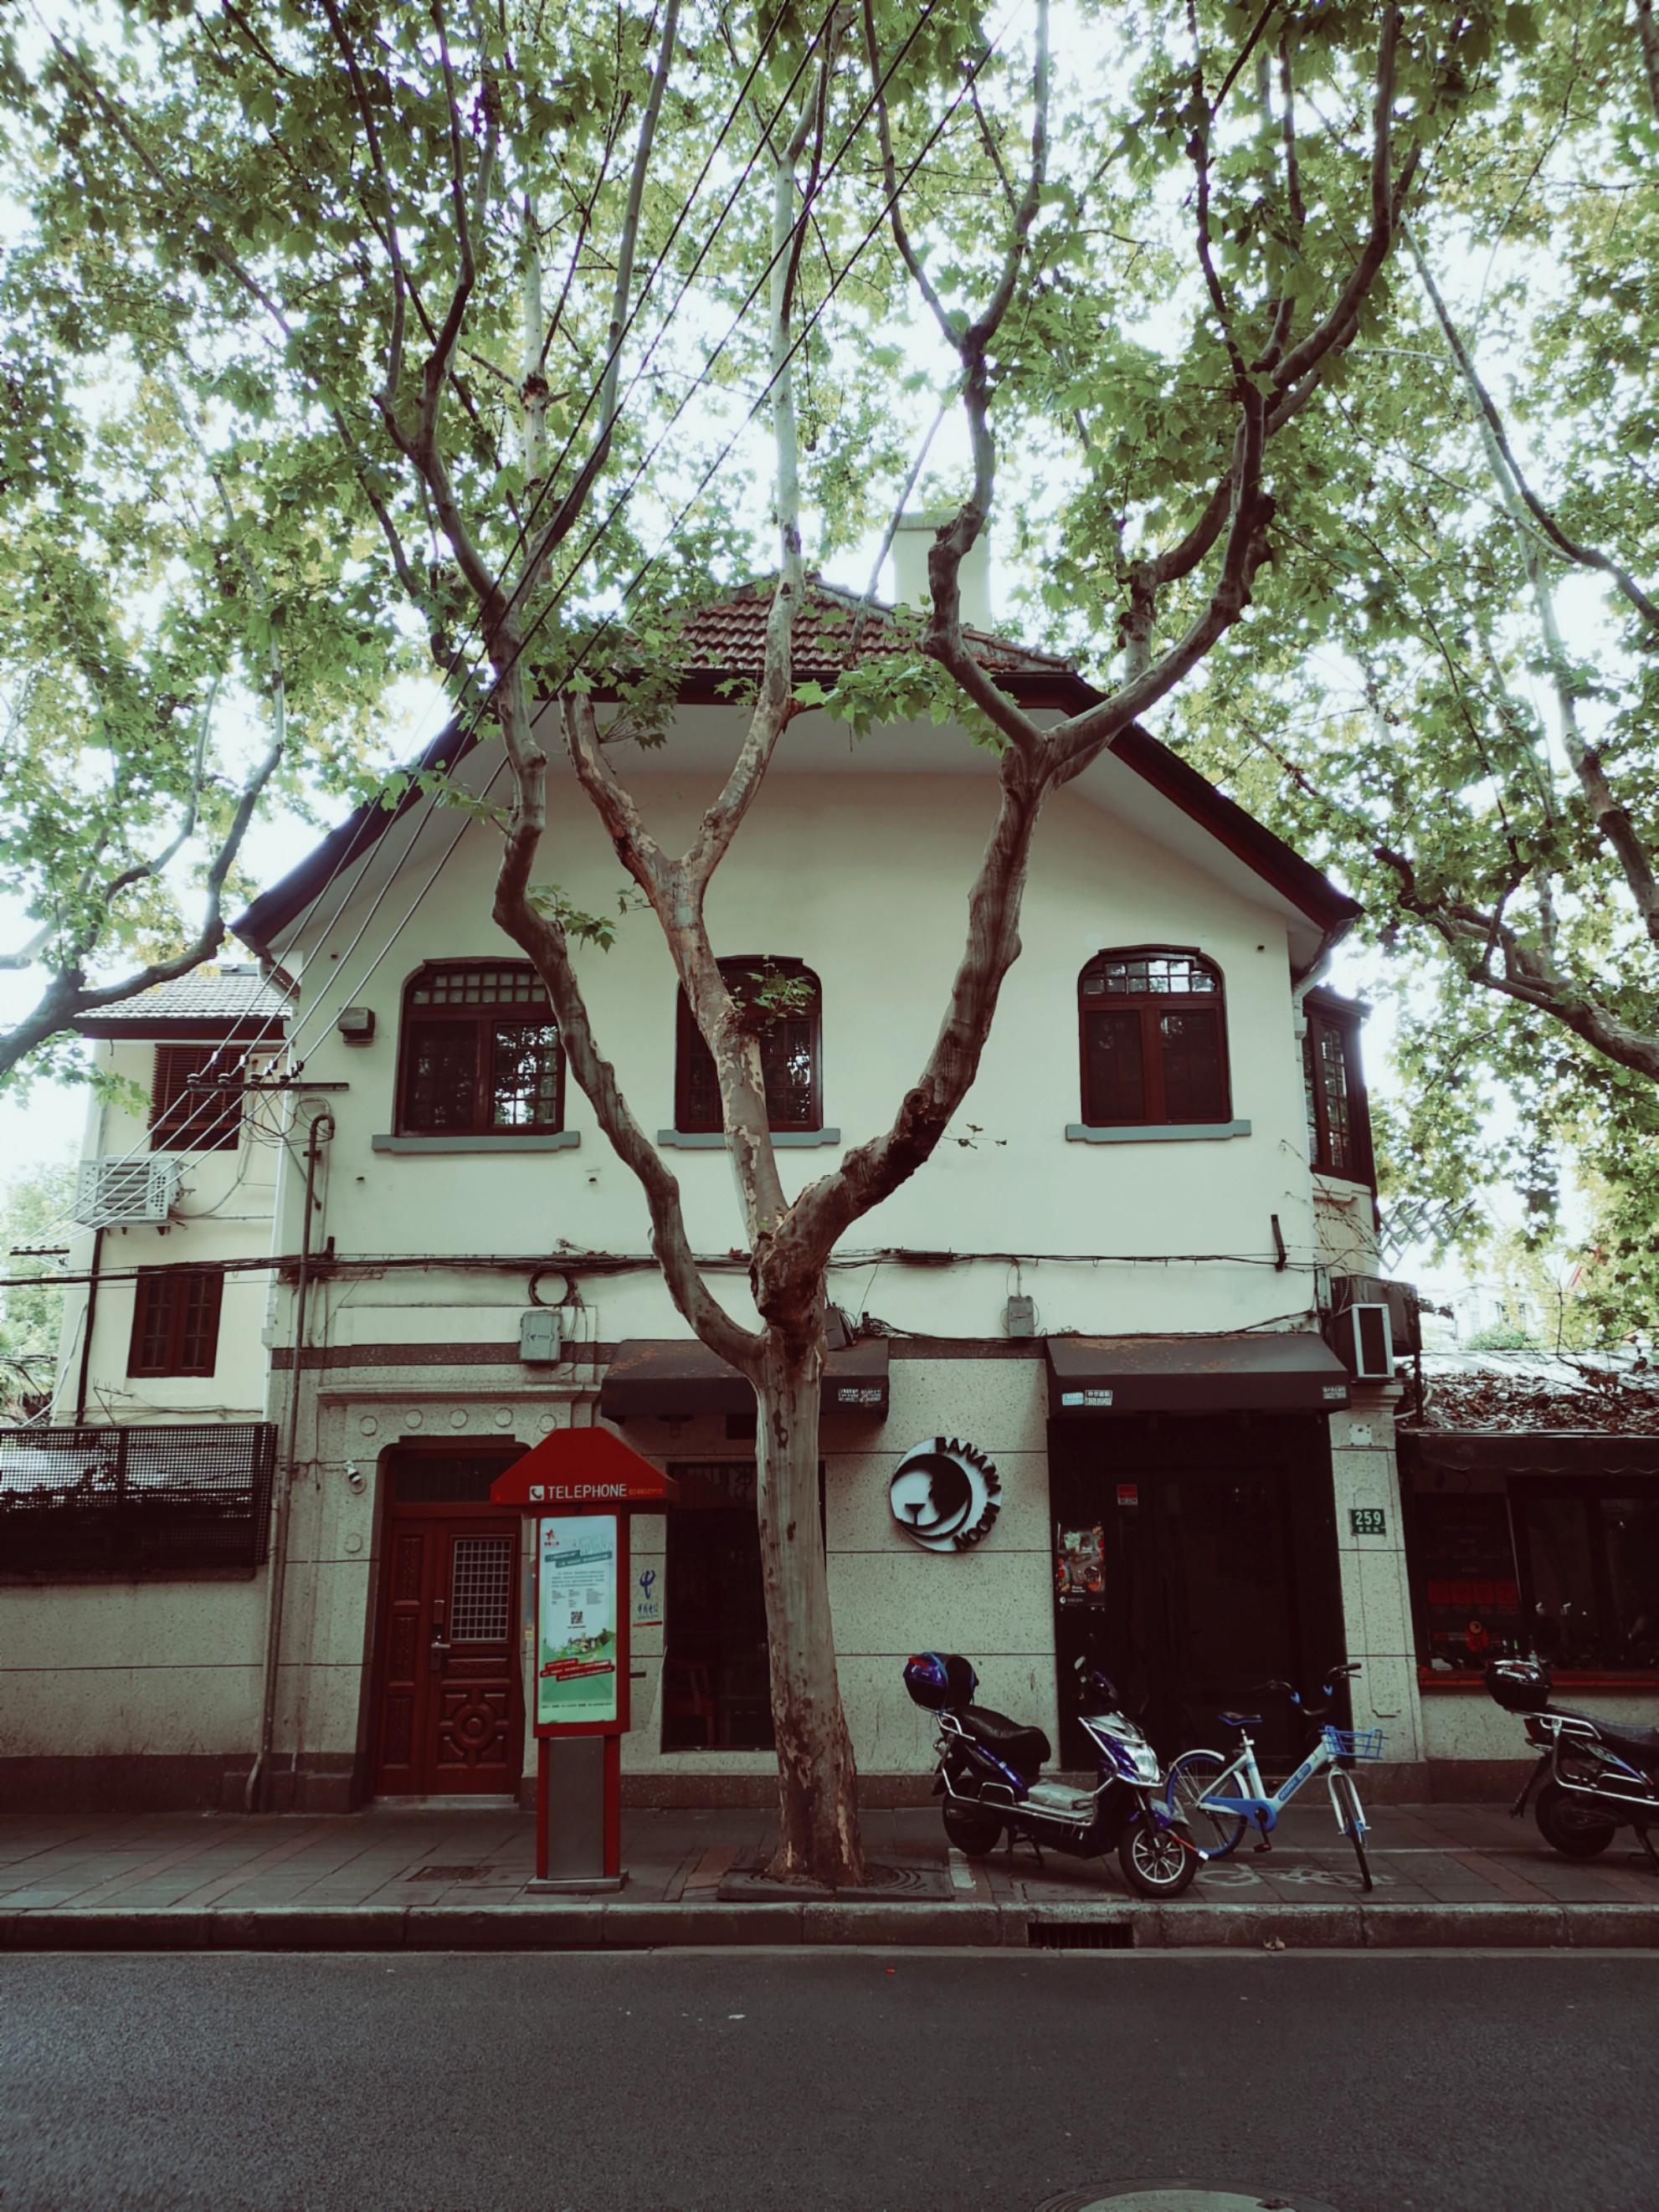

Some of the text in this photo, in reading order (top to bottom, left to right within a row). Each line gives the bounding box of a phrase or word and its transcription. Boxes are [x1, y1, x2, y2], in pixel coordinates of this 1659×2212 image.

[935, 1436, 1002, 1498] BANANA
[547, 1483, 627, 1500] TELEPHONE
[952, 1501, 1001, 1551] NOON
[1354, 1511, 1382, 1526] 259
